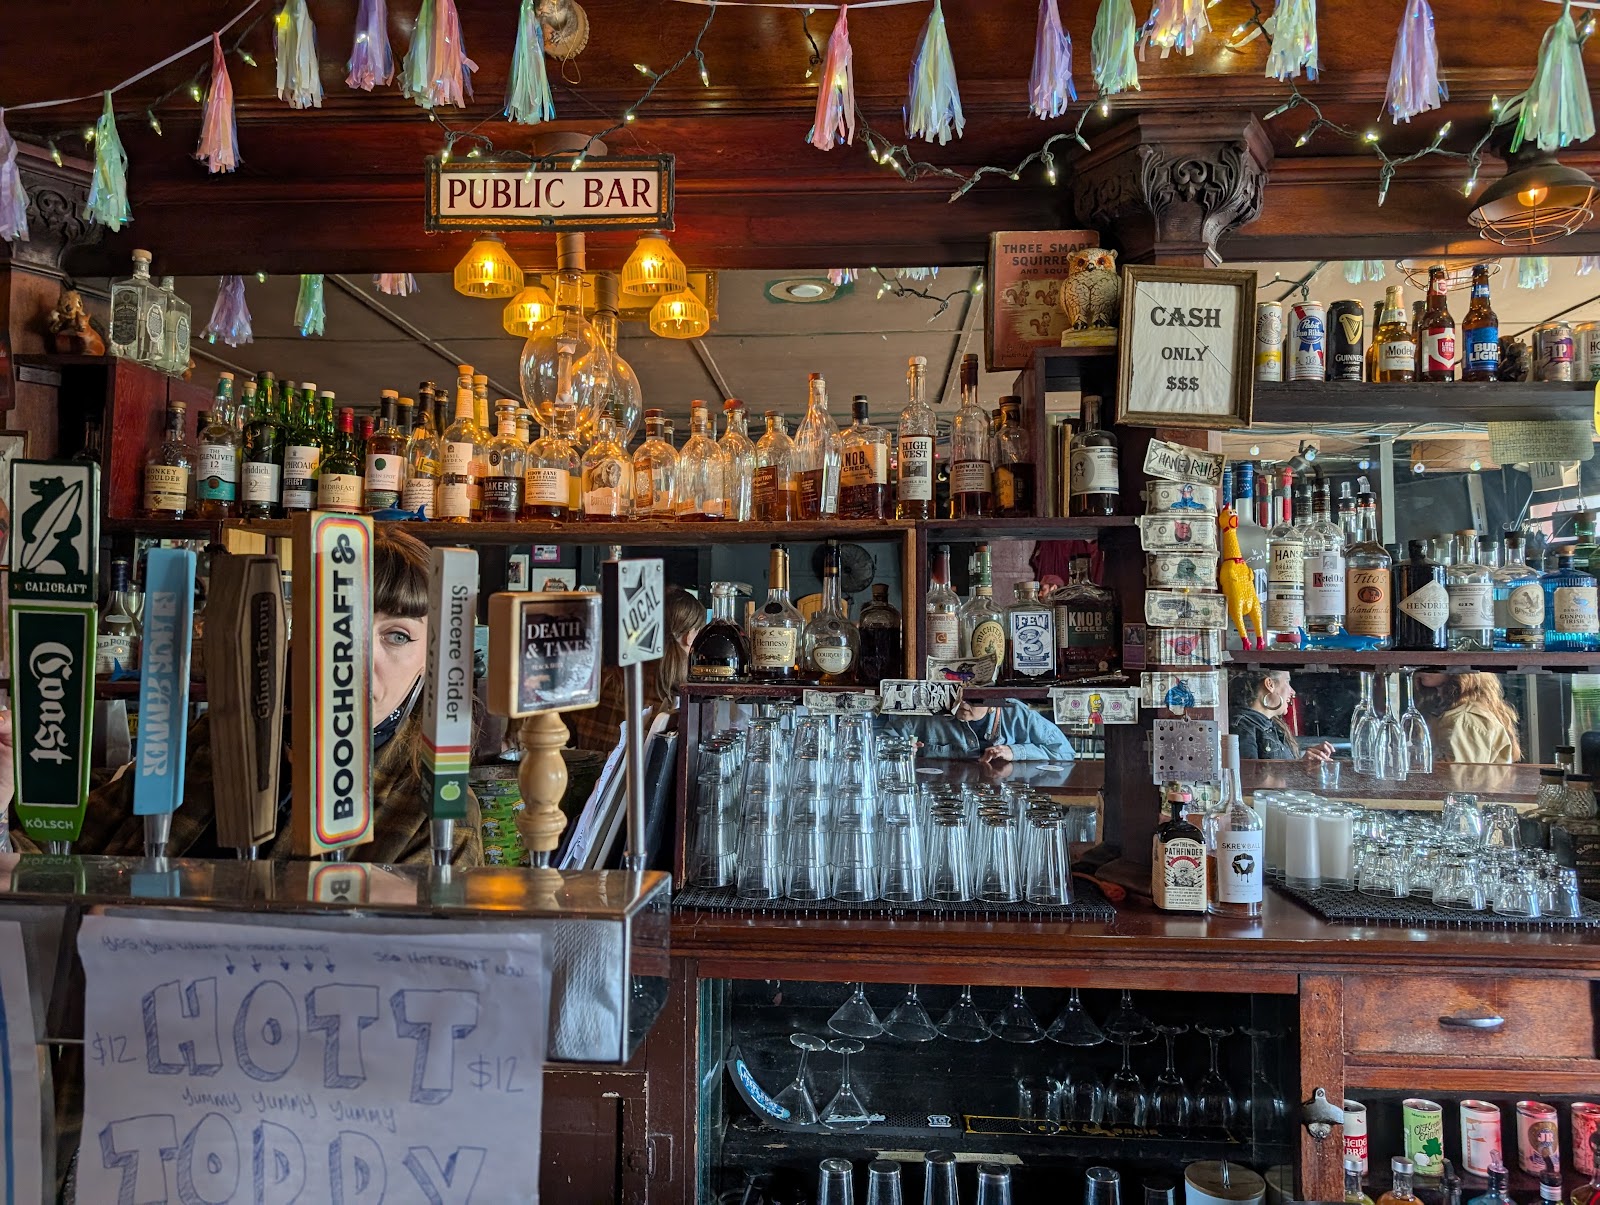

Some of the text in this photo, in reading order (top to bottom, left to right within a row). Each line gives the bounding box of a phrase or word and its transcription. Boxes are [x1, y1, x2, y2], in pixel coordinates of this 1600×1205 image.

[447, 178, 652, 208] PUBLIC BAR
[1002, 243, 1043, 255] THREE
[1012, 255, 1068, 267] SQUIRRE
[1044, 267, 1069, 275] SQUE
[1150, 306, 1222, 328] CASH
[1302, 319, 1322, 329] Pabst
[1161, 346, 1209, 362] ONLY
[1474, 343, 1498, 352] BUD
[1165, 376, 1200, 392] $$$
[902, 441, 928, 450] HIGH
[200, 453, 234, 461] GLENLIVET
[842, 450, 865, 467] NOB
[902, 450, 928, 459] WEST
[209, 460, 220, 468] 12
[285, 461, 318, 470] PHROAIG
[843, 464, 870, 473] CREEK
[321, 484, 356, 492] REDBREAST
[483, 482, 518, 491] BAKER'S
[1274, 549, 1304, 563] HANSO
[1353, 571, 1387, 584] Tito's
[25, 581, 88, 595] CALICRAFT
[622, 585, 661, 640] LOCAL
[1068, 611, 1103, 627] KNOB
[1017, 614, 1047, 627] FEW
[527, 621, 580, 640] DEATH
[756, 638, 789, 648] Hennessy
[445, 584, 469, 723] Sincere Cider
[525, 640, 592, 660] & TAXES
[257, 600, 270, 720] Ghost Town
[331, 533, 356, 821] BOOCHCRAFT &
[29, 642, 74, 765] Coast
[25, 818, 74, 830] KÖLSCH
[1164, 847, 1204, 857] PATHFINDER
[91, 976, 525, 1106] $12 HOTT $12
[1344, 1137, 1367, 1148] HEIDE
[98, 1111, 488, 1205] TODDY
